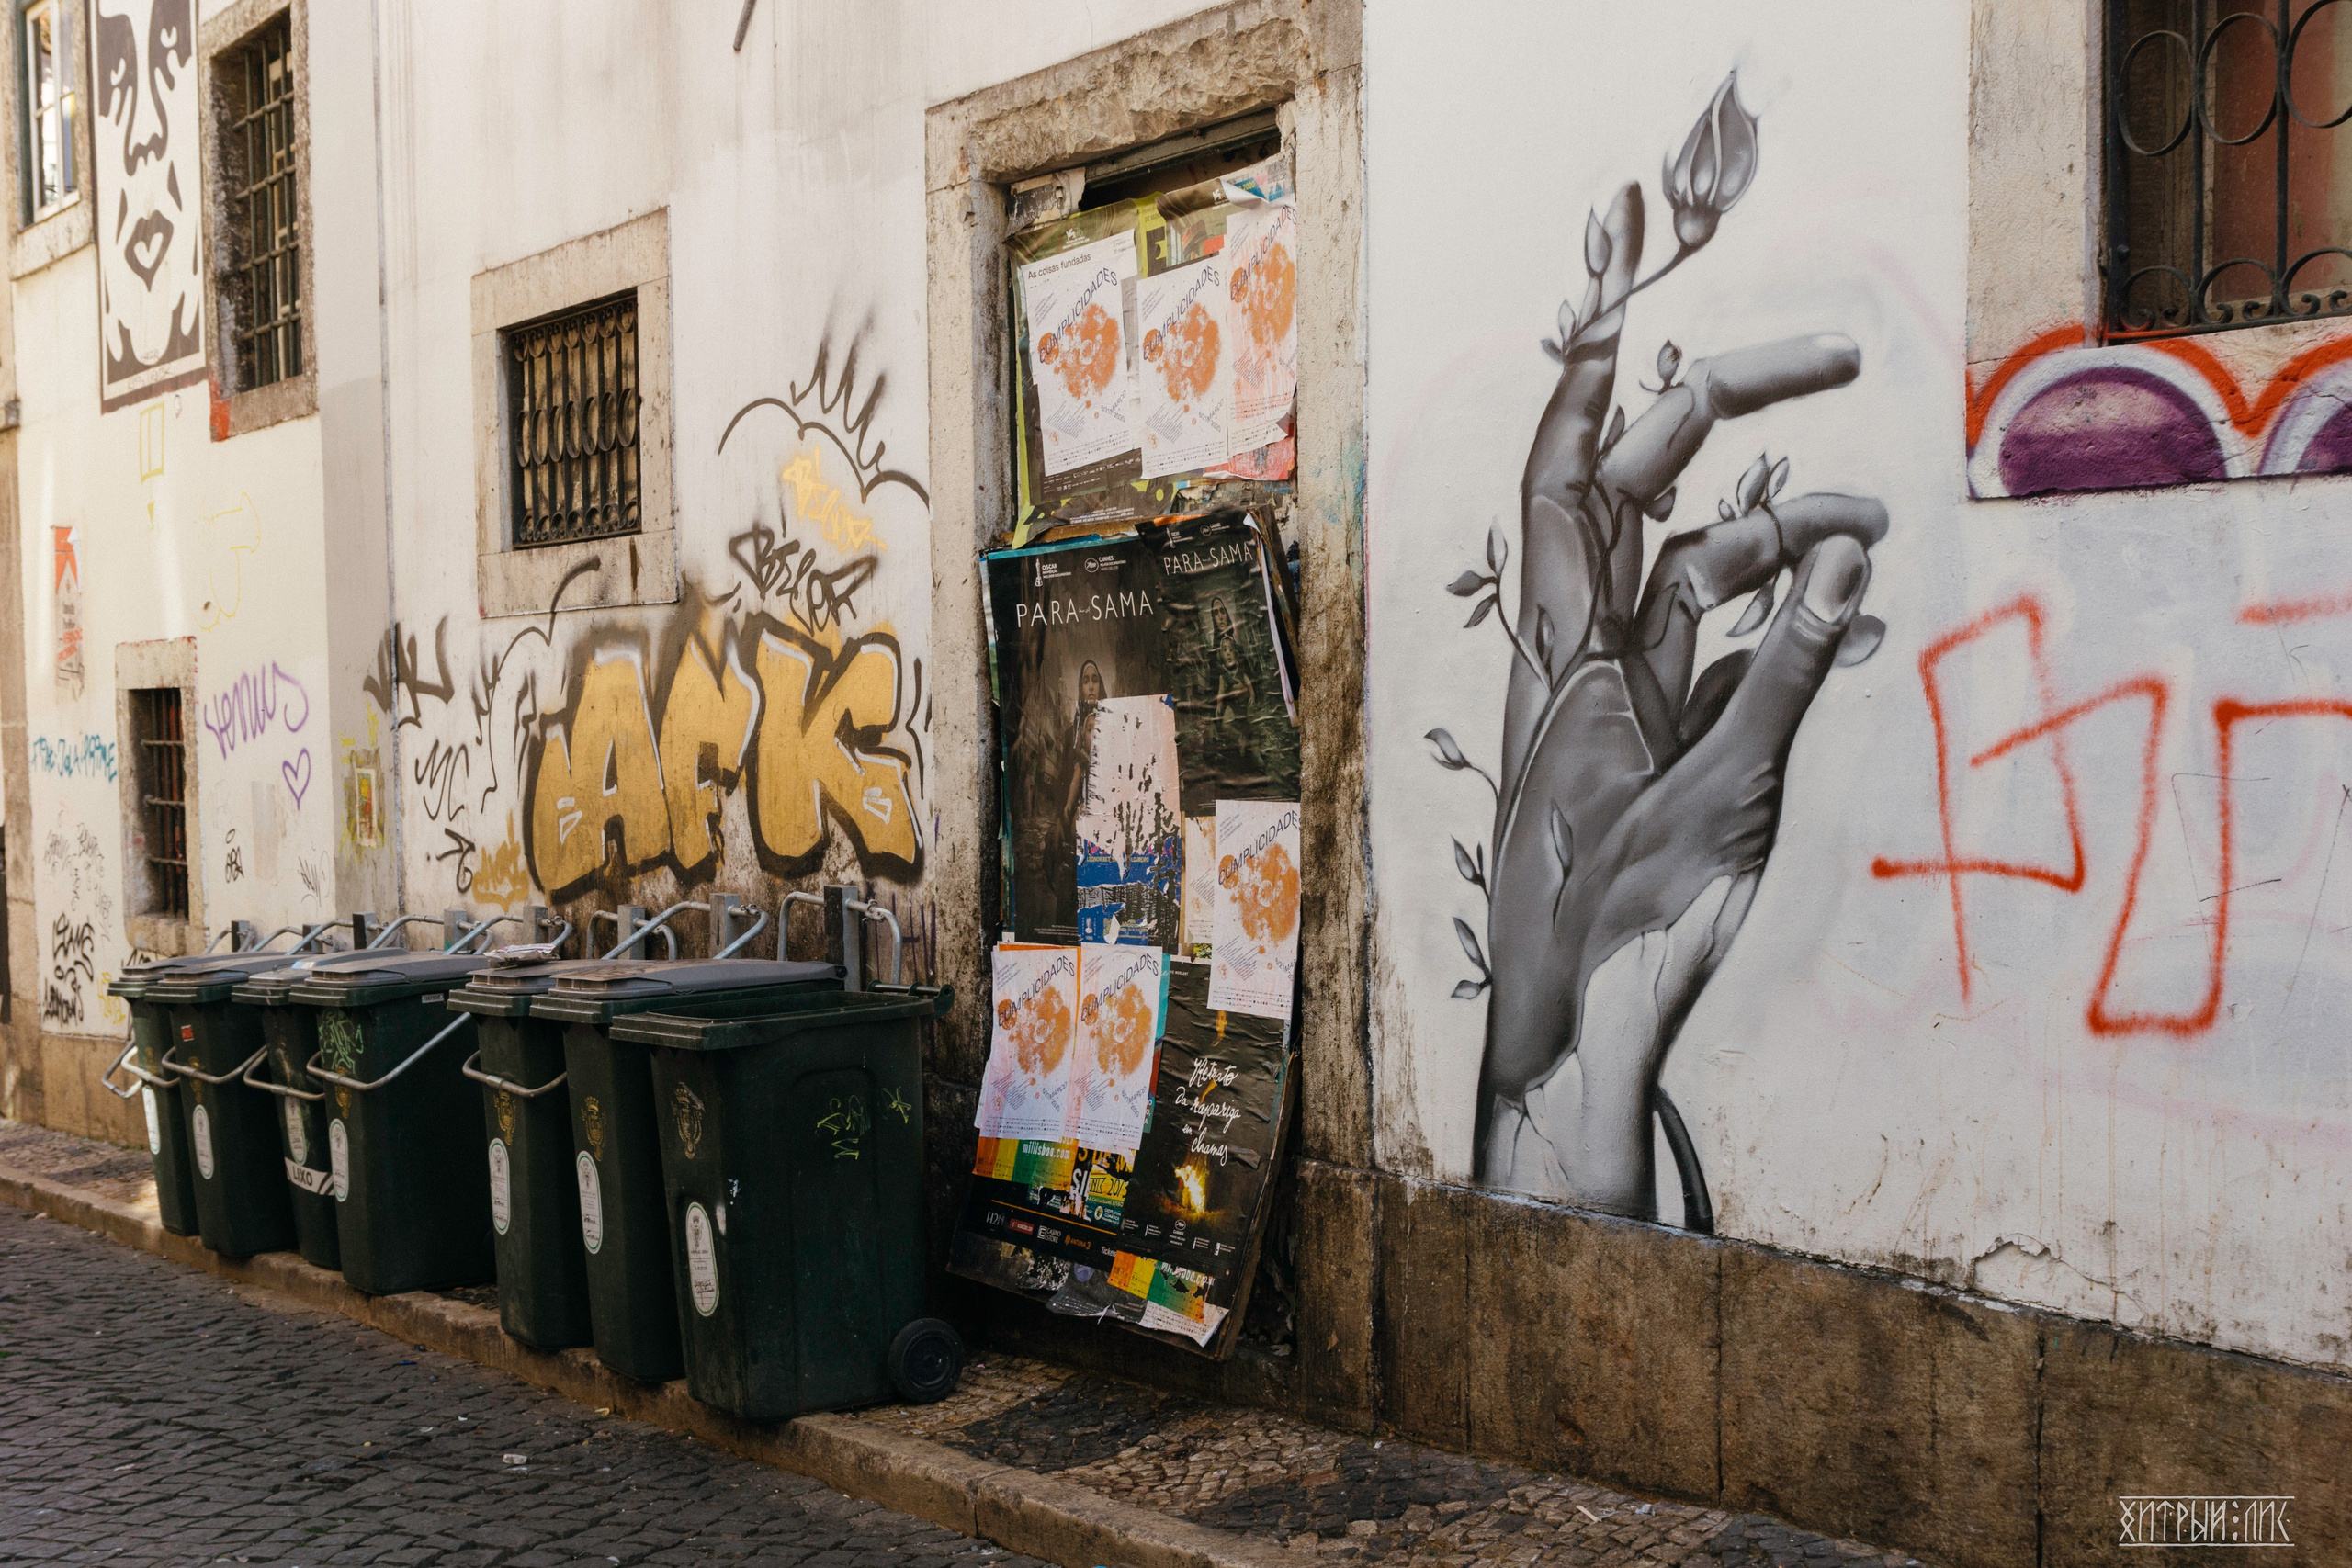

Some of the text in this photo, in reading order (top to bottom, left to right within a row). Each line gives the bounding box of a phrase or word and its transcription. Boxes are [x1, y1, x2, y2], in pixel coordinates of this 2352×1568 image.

[1028, 252, 1091, 280] As coisas fundadas
[1039, 267, 1117, 363] CUMPLICIDADES
[1143, 265, 1220, 360] CUMPLICIDADES
[1163, 543, 1253, 576] PARA SAMA
[1016, 590, 1154, 628] PARA SAMA
[998, 954, 1075, 1027] CUMPLICIDADES
[1080, 953, 1159, 1021] CUMPLICIDADES
[1188, 1057, 1239, 1088] Retrato
[1190, 1096, 1241, 1134] rapariga
[1191, 1127, 1228, 1167] chamas
[291, 1165, 313, 1187] LIXO
[1101, 1246, 1117, 1258] Tickets
